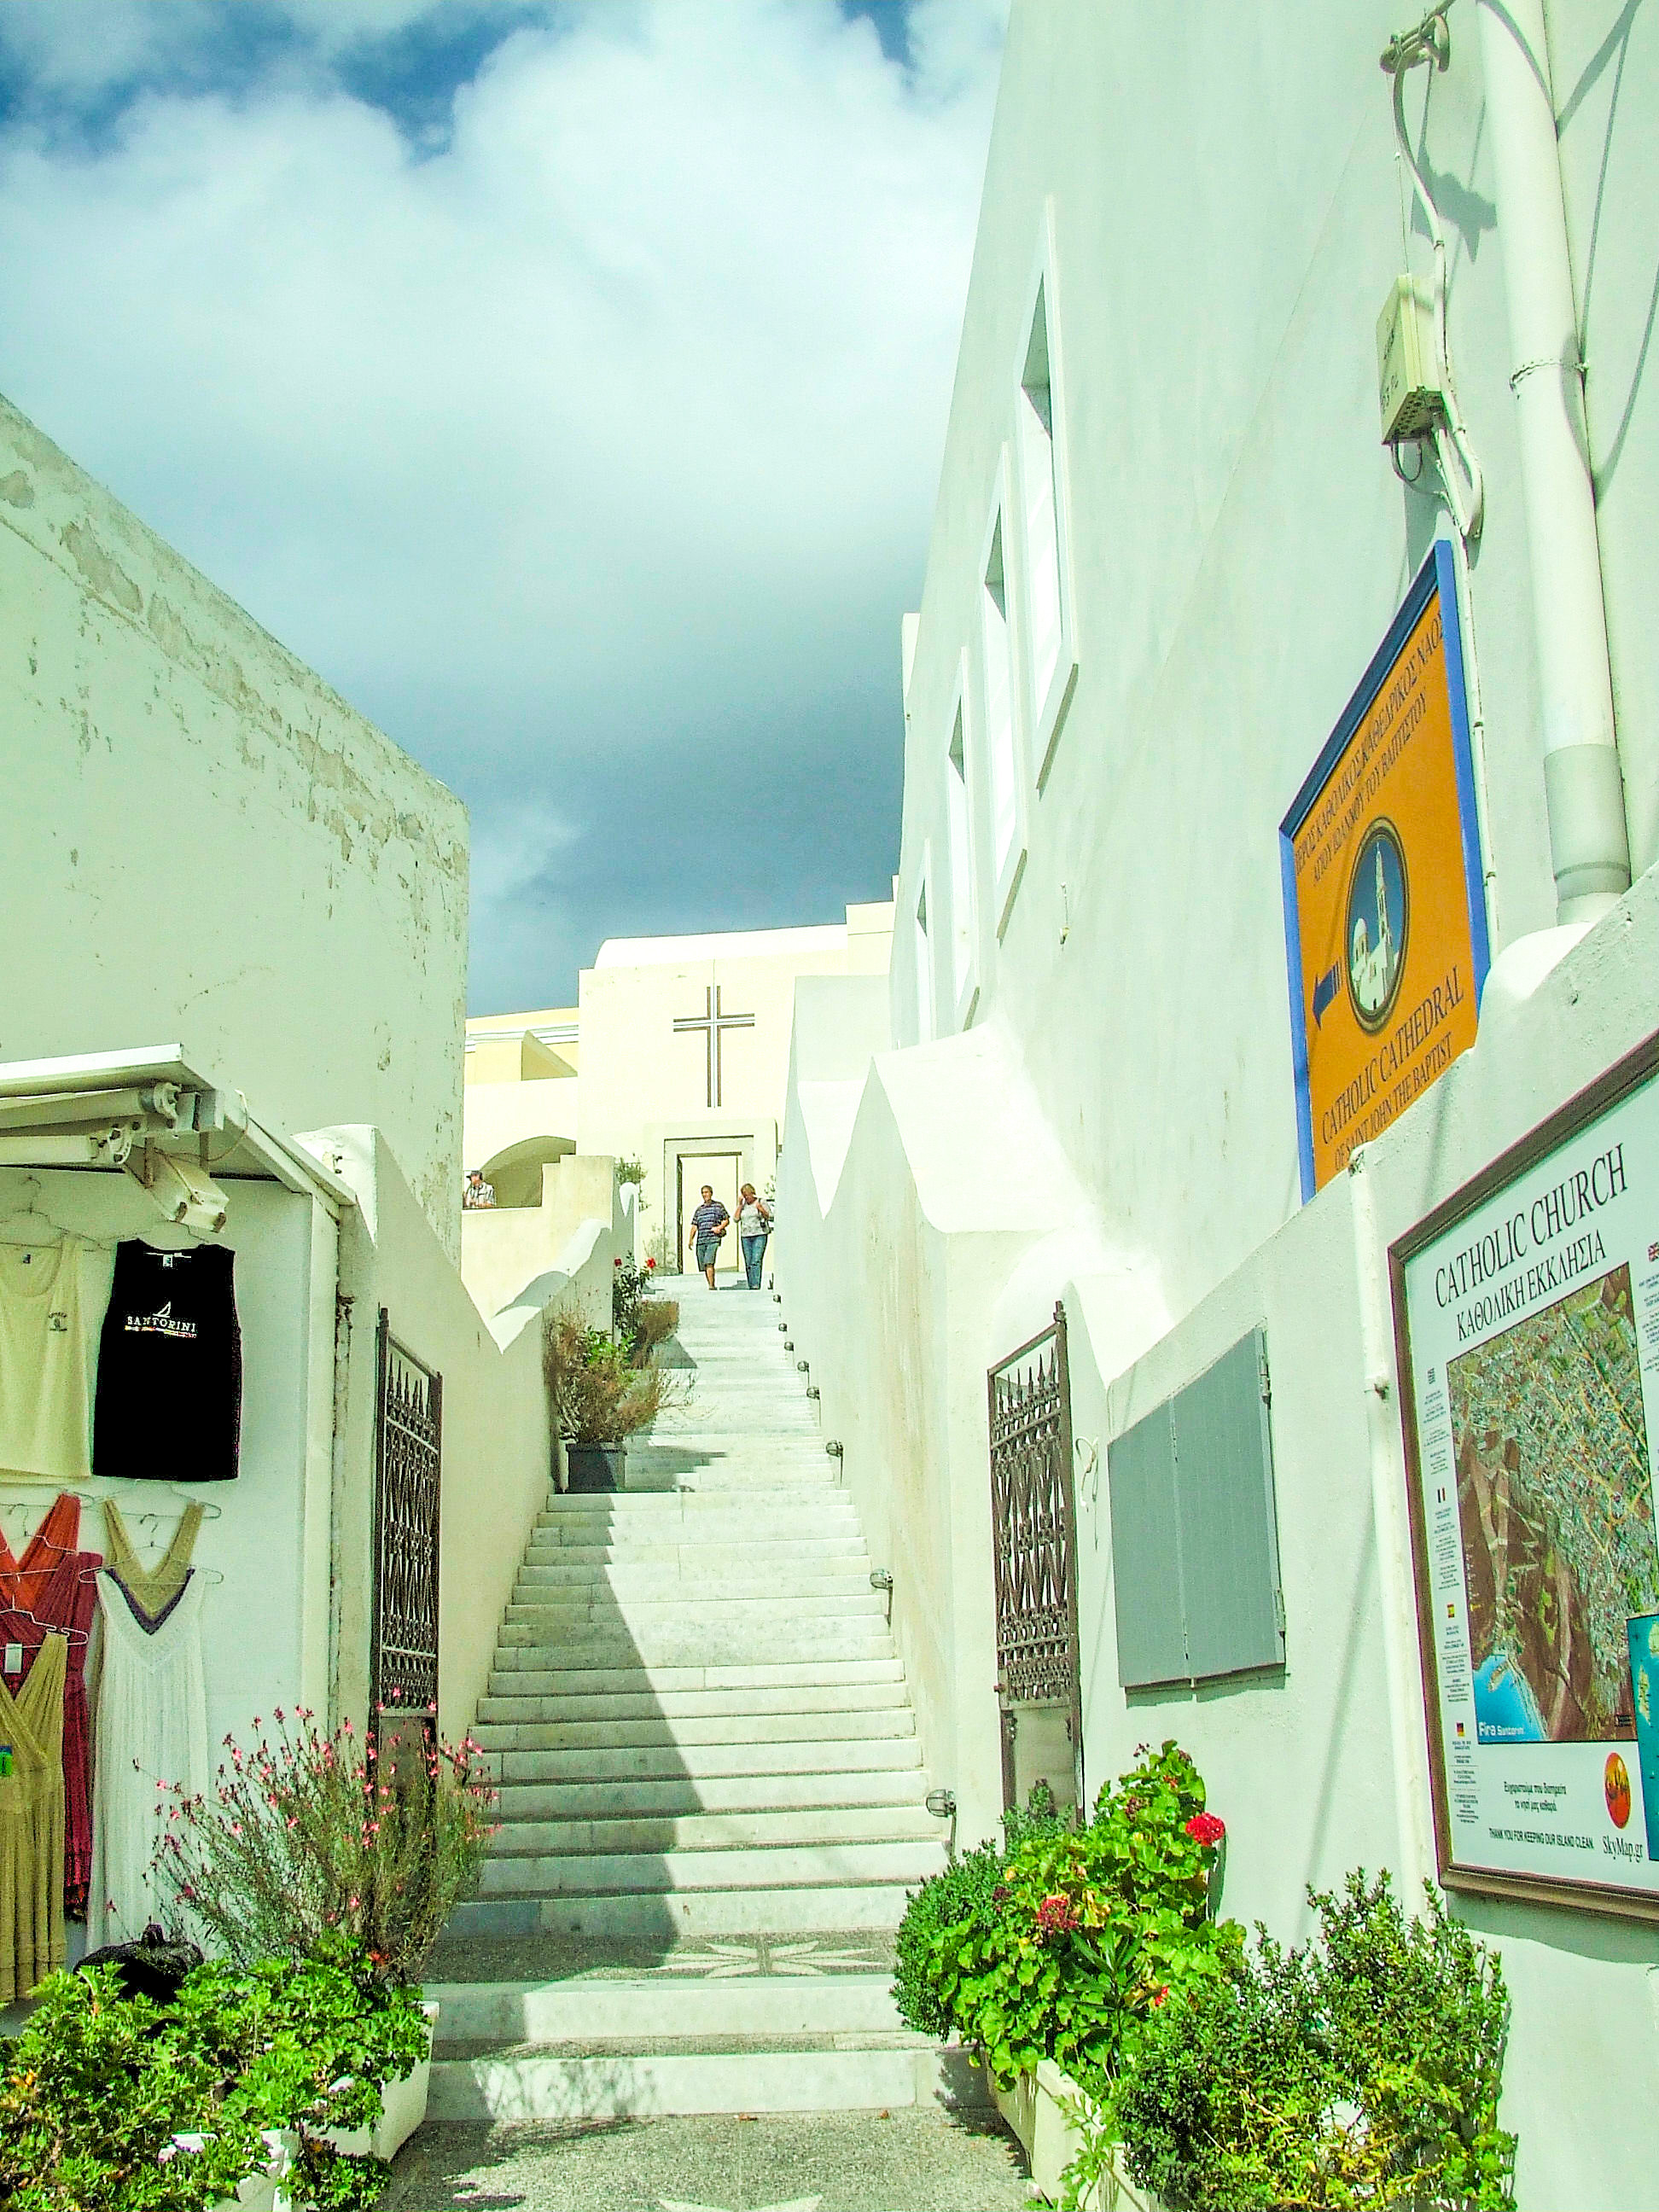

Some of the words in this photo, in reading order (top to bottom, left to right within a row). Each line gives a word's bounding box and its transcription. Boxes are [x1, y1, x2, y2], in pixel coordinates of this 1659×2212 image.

[1322, 1058, 1378, 1145] CATHOLIC
[1379, 965, 1464, 1082] CATHEDRAL
[1369, 1100, 1391, 1136] JOHN
[1390, 1074, 1412, 1110] THE
[1412, 1031, 1452, 1093] BAPTIST
[1435, 1212, 1528, 1308] CATHOLIC
[1530, 1142, 1628, 1246] CHURCH
[127, 1315, 196, 1333] SANTORINI
[1456, 1275, 1526, 1342] ΚΑΘΟΛΙΚΗ
[1527, 1229, 1607, 1301] ΕΚΚΛΗΣΙΑ
[1513, 1830, 1523, 1842] FOR
[1523, 1831, 1545, 1844] KEEPING
[1545, 1833, 1556, 1845] OUR
[1556, 1834, 1575, 1848] ISLAND
[1602, 1835, 1644, 1863] SkyMap.gr
